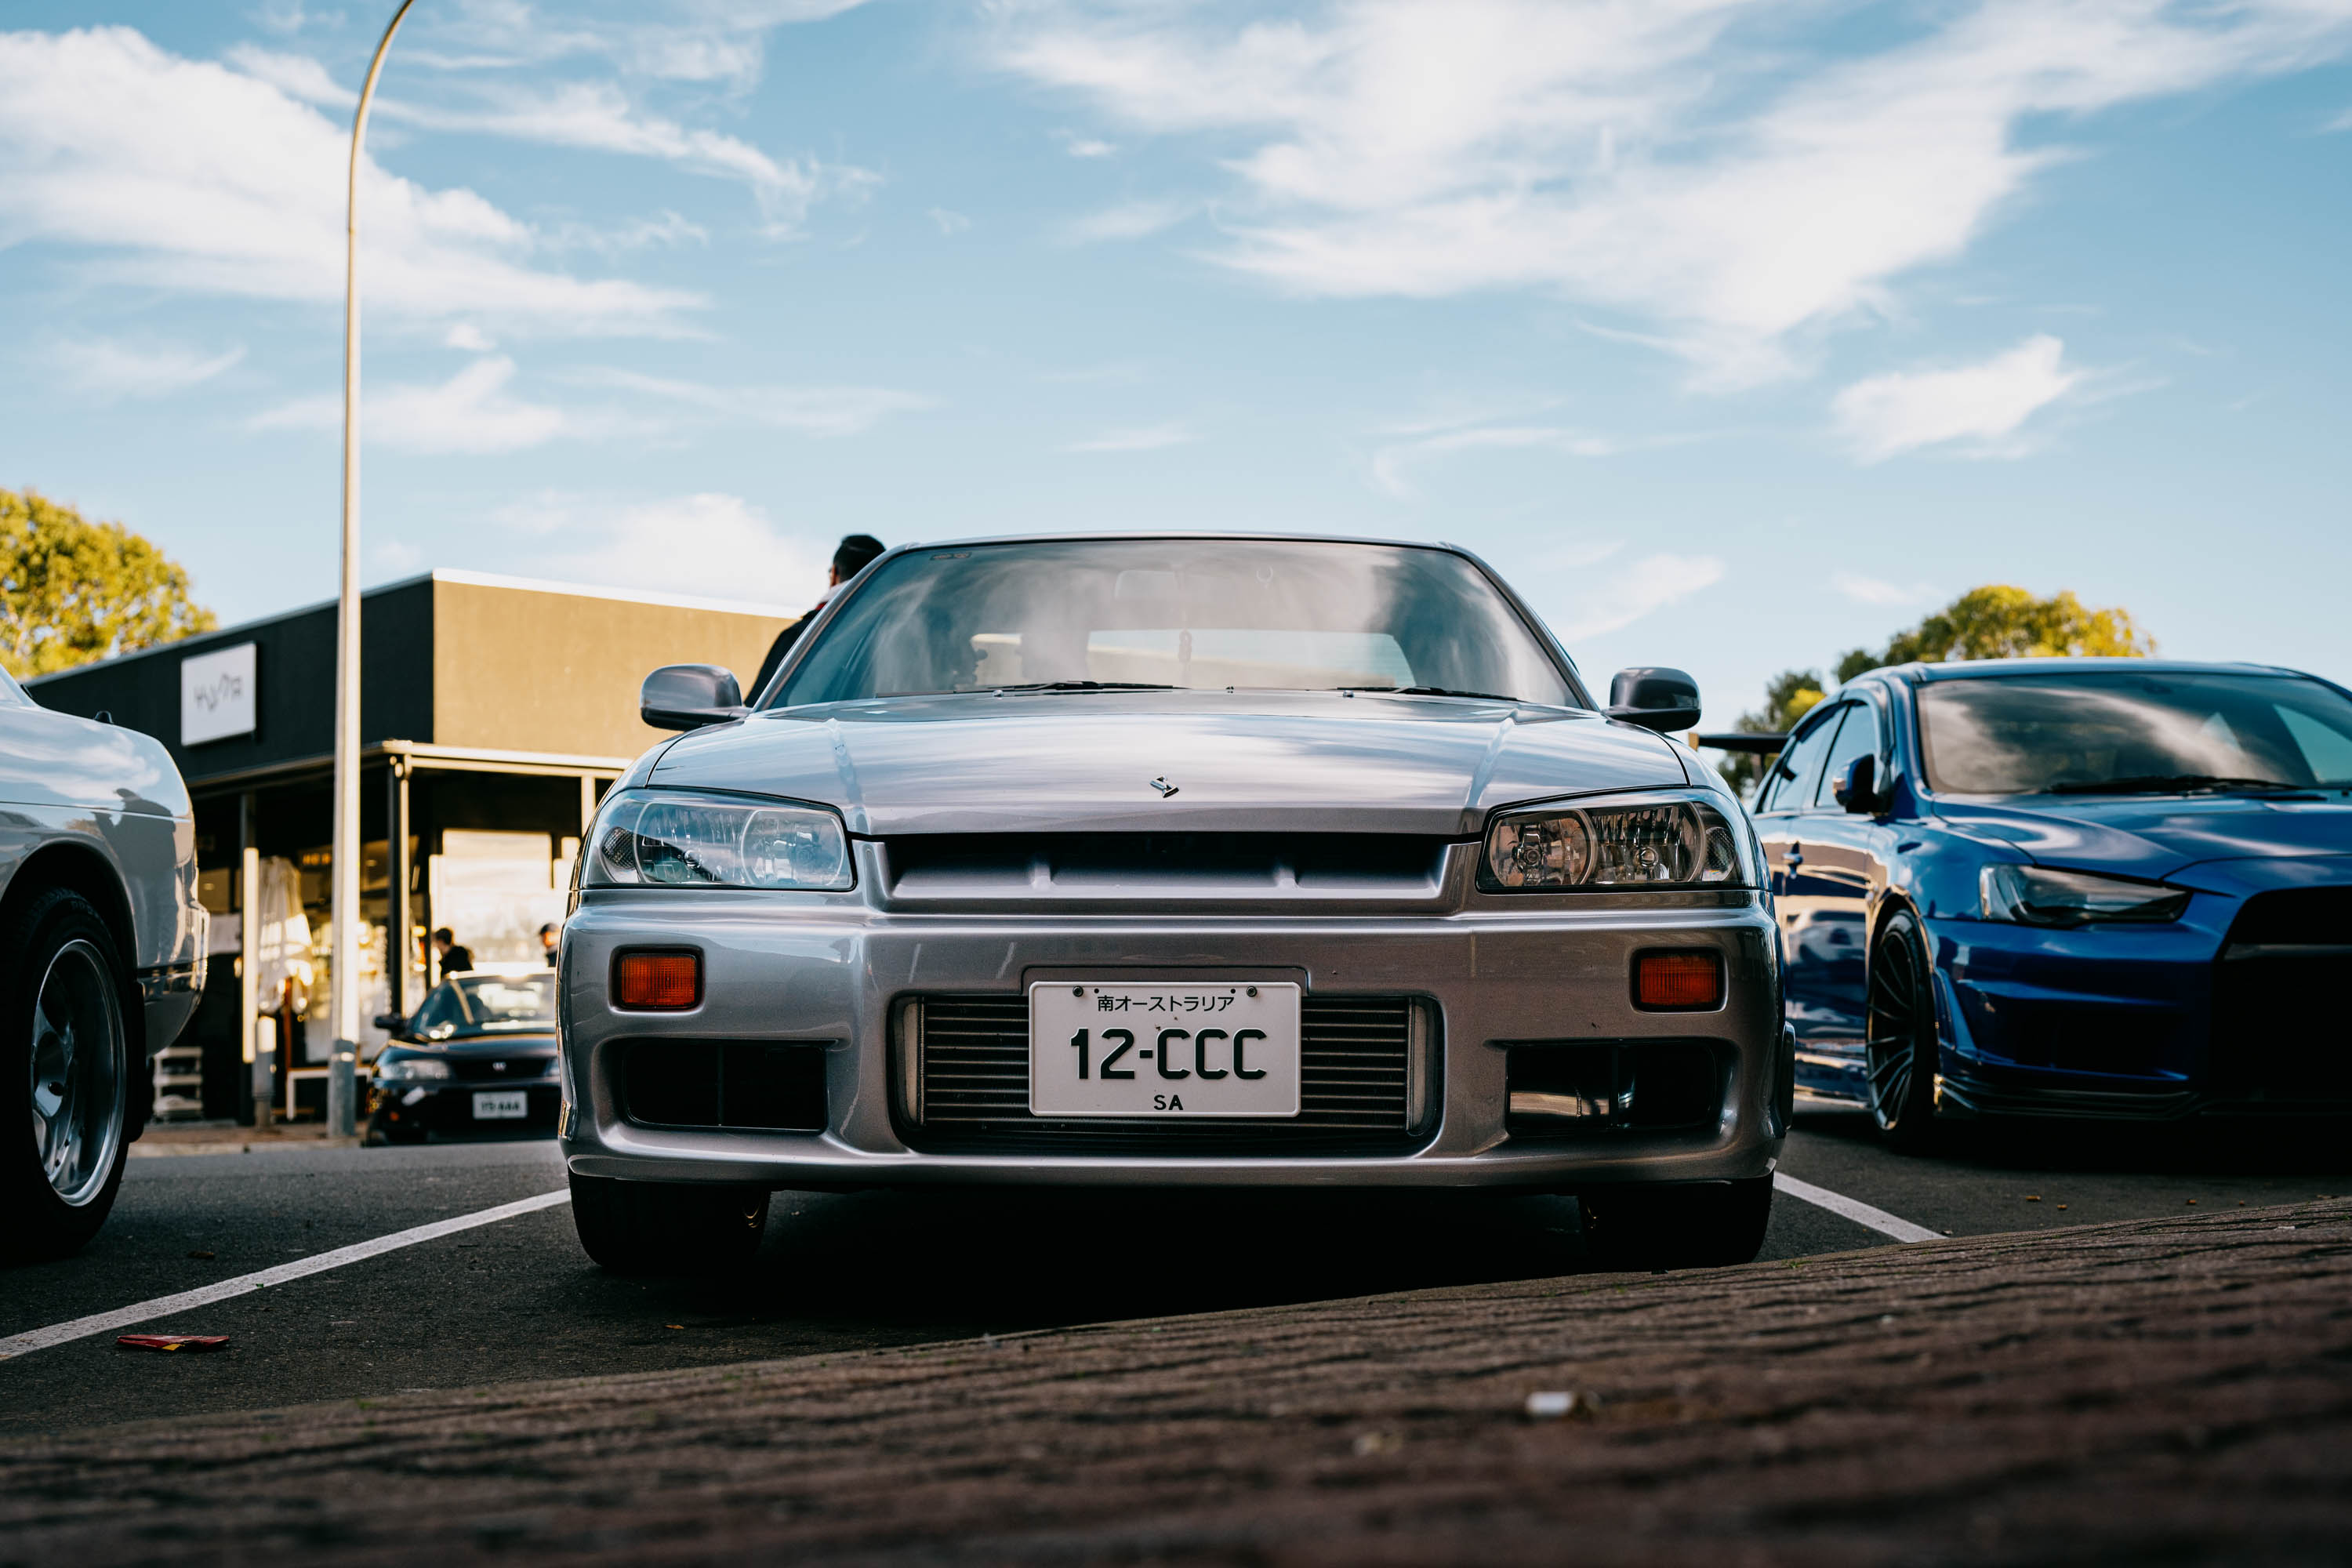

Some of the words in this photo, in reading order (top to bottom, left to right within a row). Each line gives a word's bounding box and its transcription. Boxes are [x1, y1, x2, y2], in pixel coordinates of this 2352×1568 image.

[1098, 995, 1235, 1011] 南オーストラリア
[1071, 1028, 1267, 1080] 12-CCC
[1153, 1094, 1184, 1111] SA
